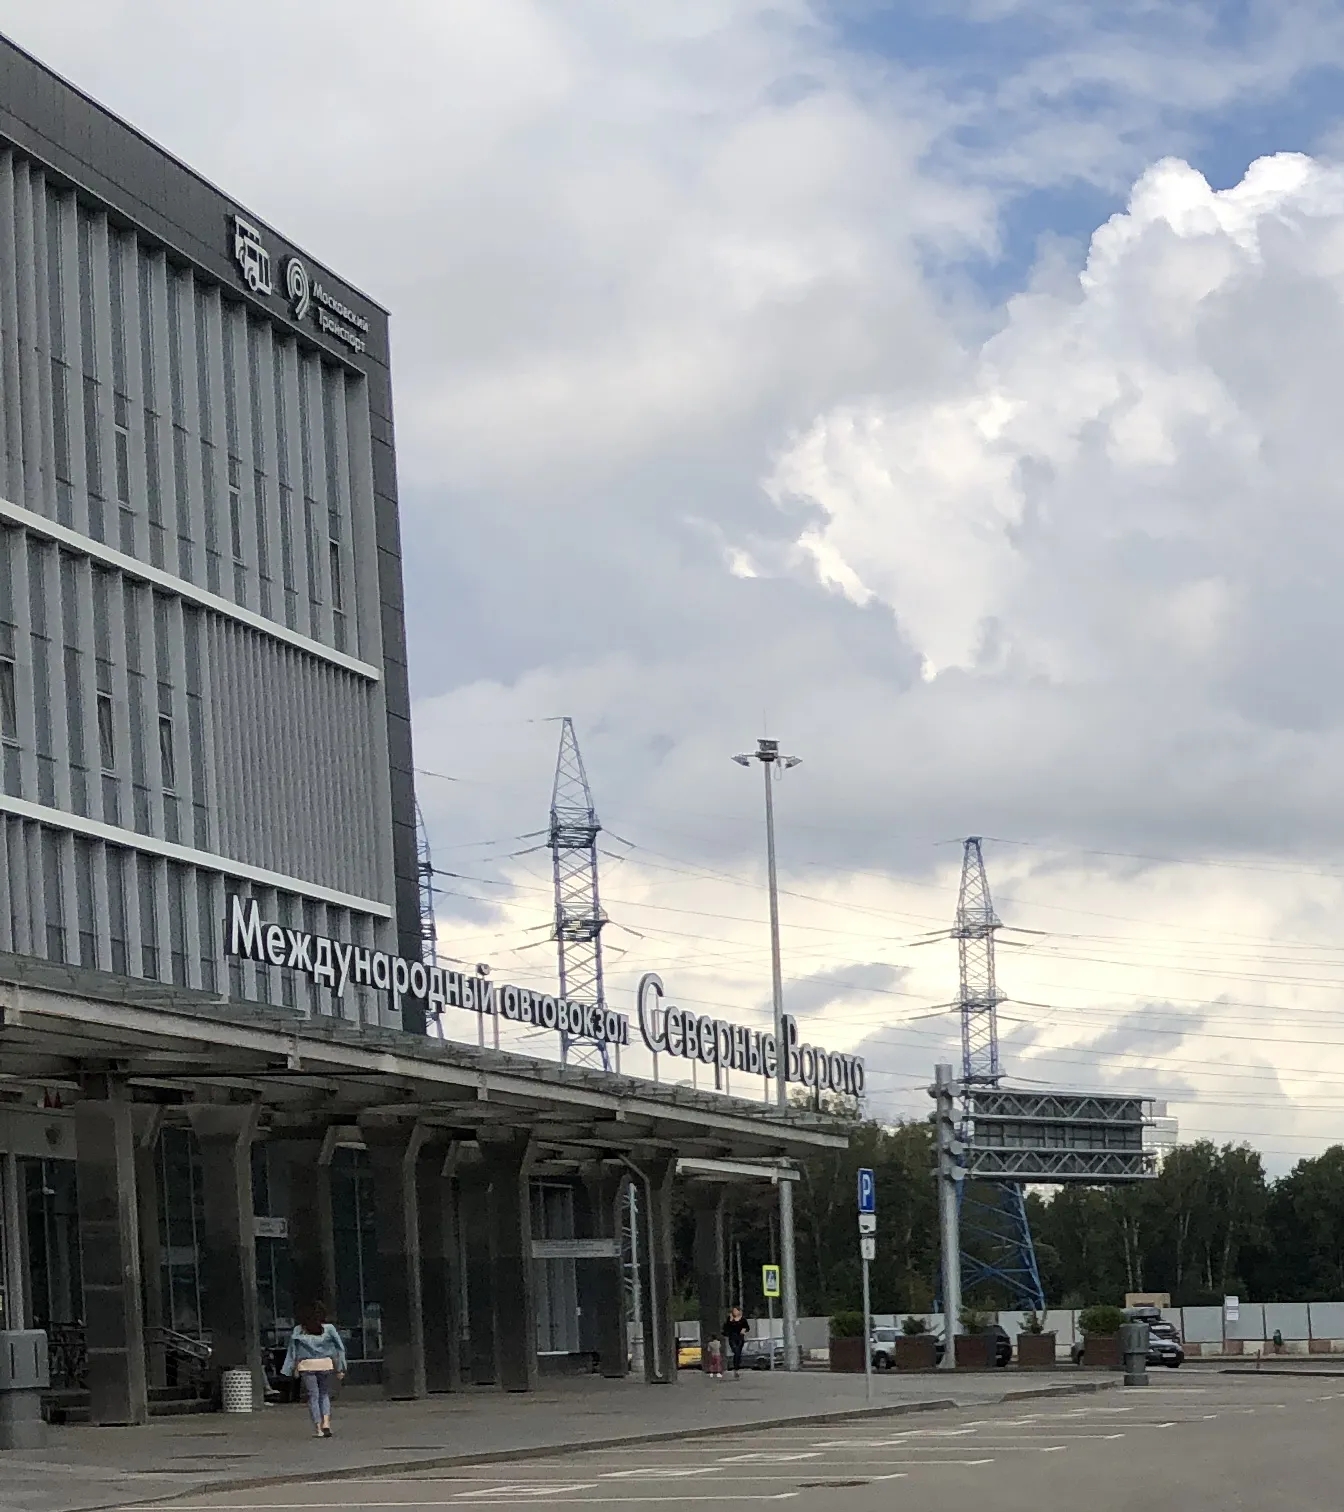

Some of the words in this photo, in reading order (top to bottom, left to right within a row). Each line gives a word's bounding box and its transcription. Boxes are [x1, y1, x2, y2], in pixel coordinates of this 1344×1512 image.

[231, 894, 495, 1014] Международный
[504, 984, 630, 1045] автовокзал
[638, 973, 778, 1090] Северные
[781, 1014, 866, 1110] Ворота
[862, 1173, 871, 1207] P
